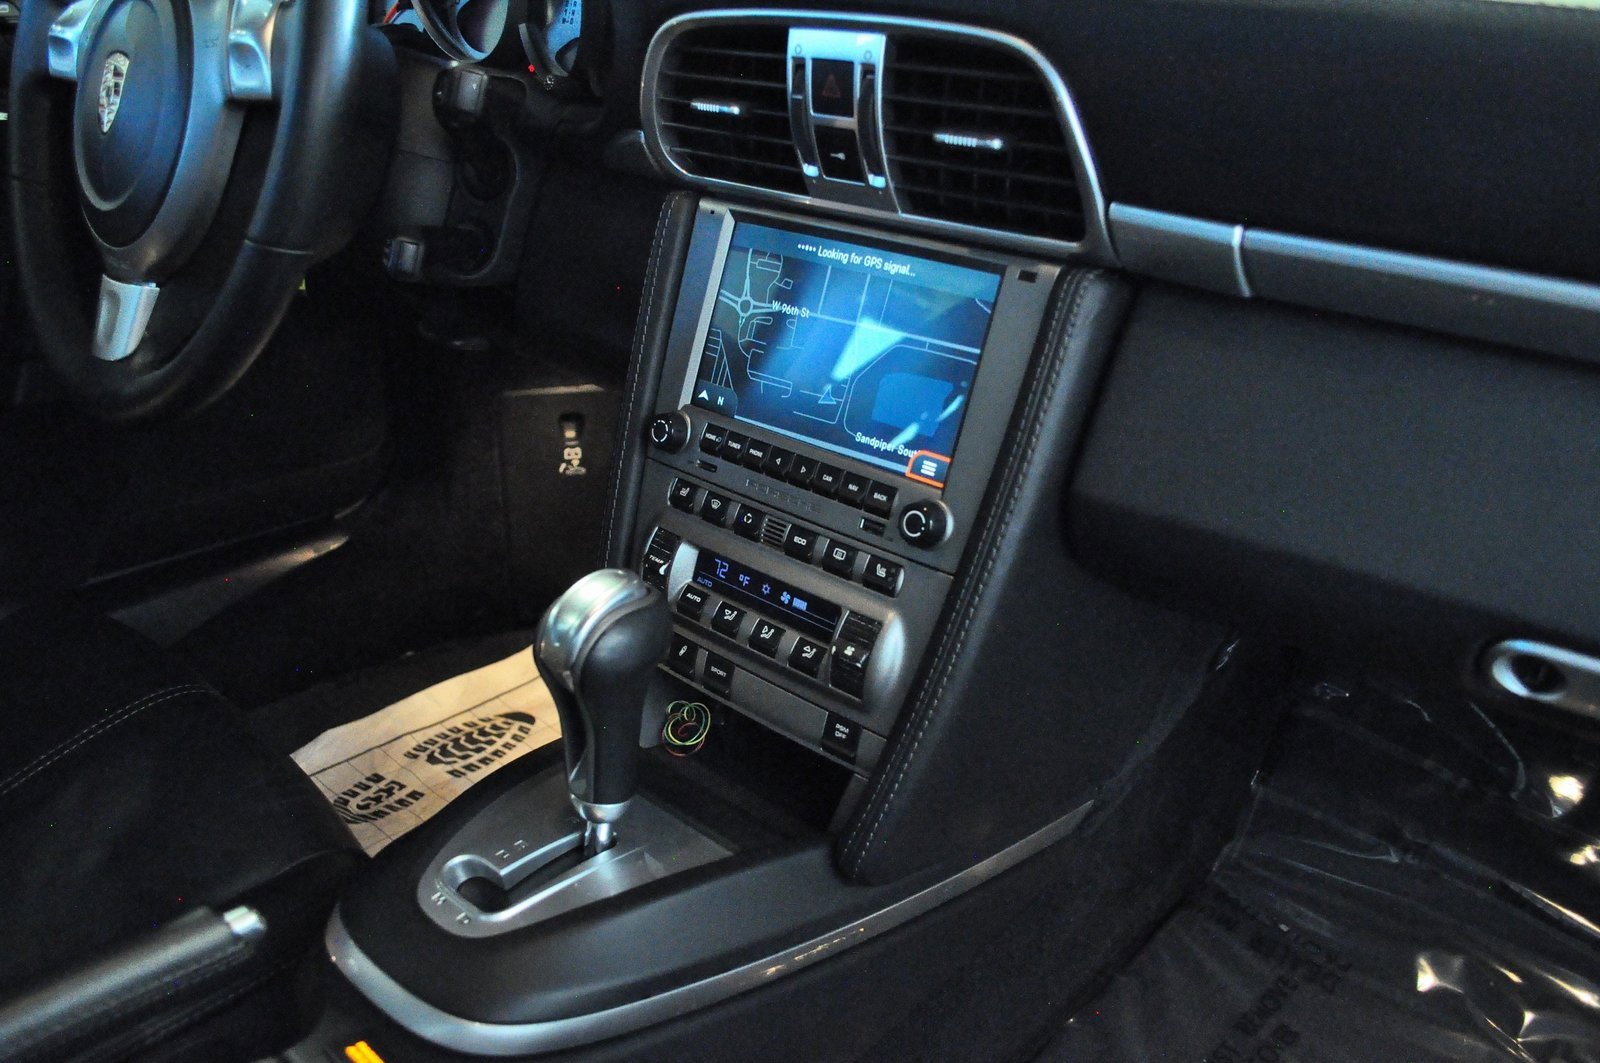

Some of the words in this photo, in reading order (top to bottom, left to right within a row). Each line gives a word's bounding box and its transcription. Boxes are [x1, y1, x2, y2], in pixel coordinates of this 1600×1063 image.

[818, 245, 849, 264] Looking
[850, 252, 863, 264] for
[863, 255, 883, 269] GPS
[772, 300, 781, 311] W
[781, 303, 799, 316] 96th
[800, 307, 810, 319] St
[717, 395, 724, 406] N
[855, 431, 895, 452] Sandpiper
[822, 474, 833, 483] CAR
[873, 492, 888, 502] BACK
[793, 535, 807, 546] ECO
[649, 554, 664, 564] TEMP
[714, 558, 729, 579] 72
[696, 576, 713, 588] AUTO
[686, 592, 702, 603] AUTO
[710, 665, 727, 678] SPORT
